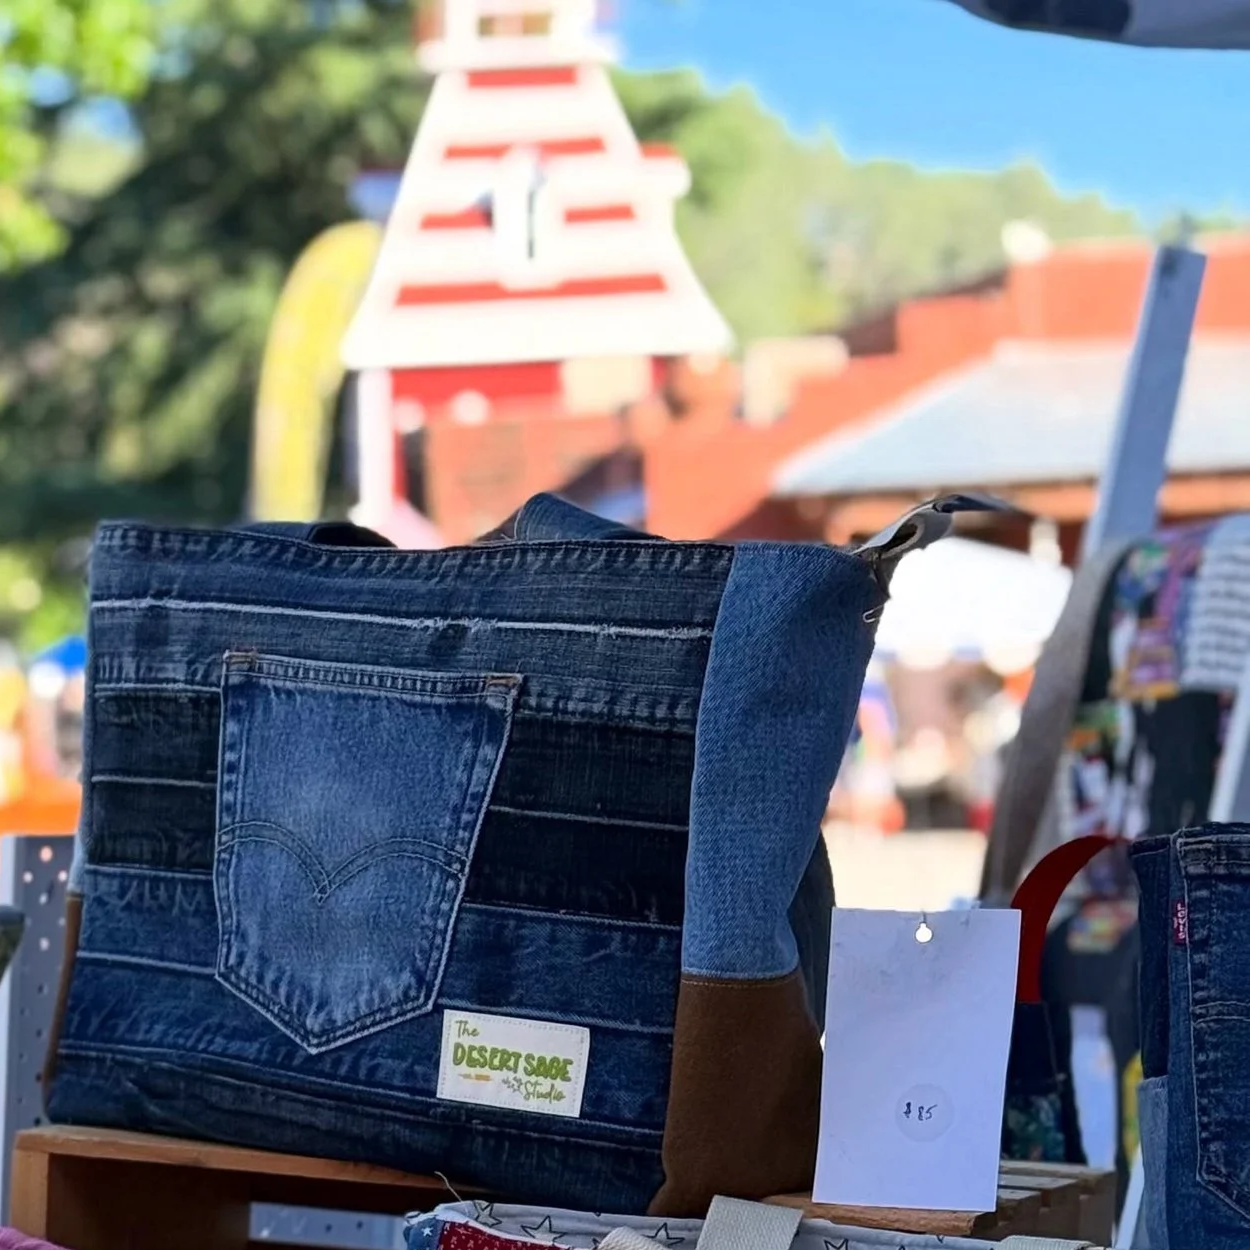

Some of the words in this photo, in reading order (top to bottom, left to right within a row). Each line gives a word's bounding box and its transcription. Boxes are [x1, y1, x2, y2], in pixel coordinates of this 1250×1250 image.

[455, 1020, 480, 1038] The
[452, 1042, 522, 1074] DESERT
[523, 1053, 574, 1082] SAGE
[523, 1080, 566, 1104] Studio
